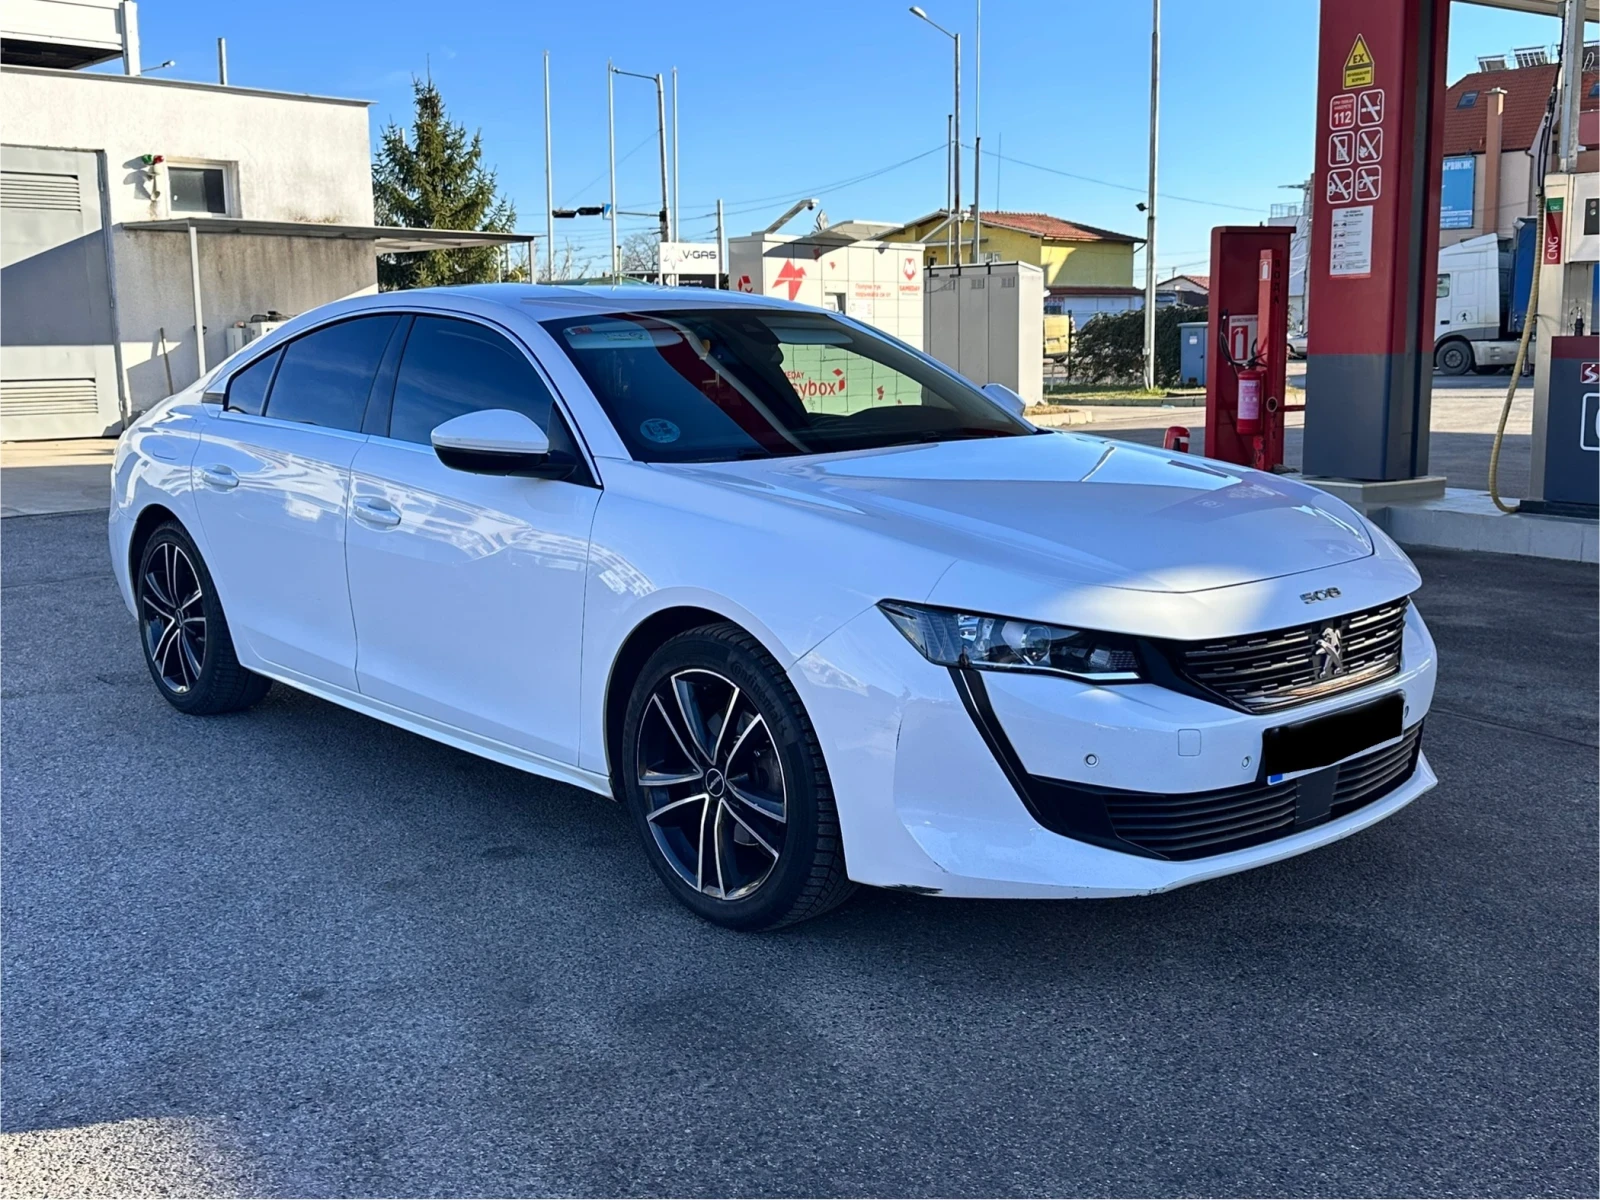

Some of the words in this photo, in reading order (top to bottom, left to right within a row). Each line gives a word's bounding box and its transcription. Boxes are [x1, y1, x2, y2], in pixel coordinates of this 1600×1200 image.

[1353, 53, 1365, 64] EX
[1333, 110, 1352, 125] 112
[682, 250, 717, 259] V-GAS
[1547, 236, 1559, 260] CNG
[1299, 586, 1342, 604] 508
